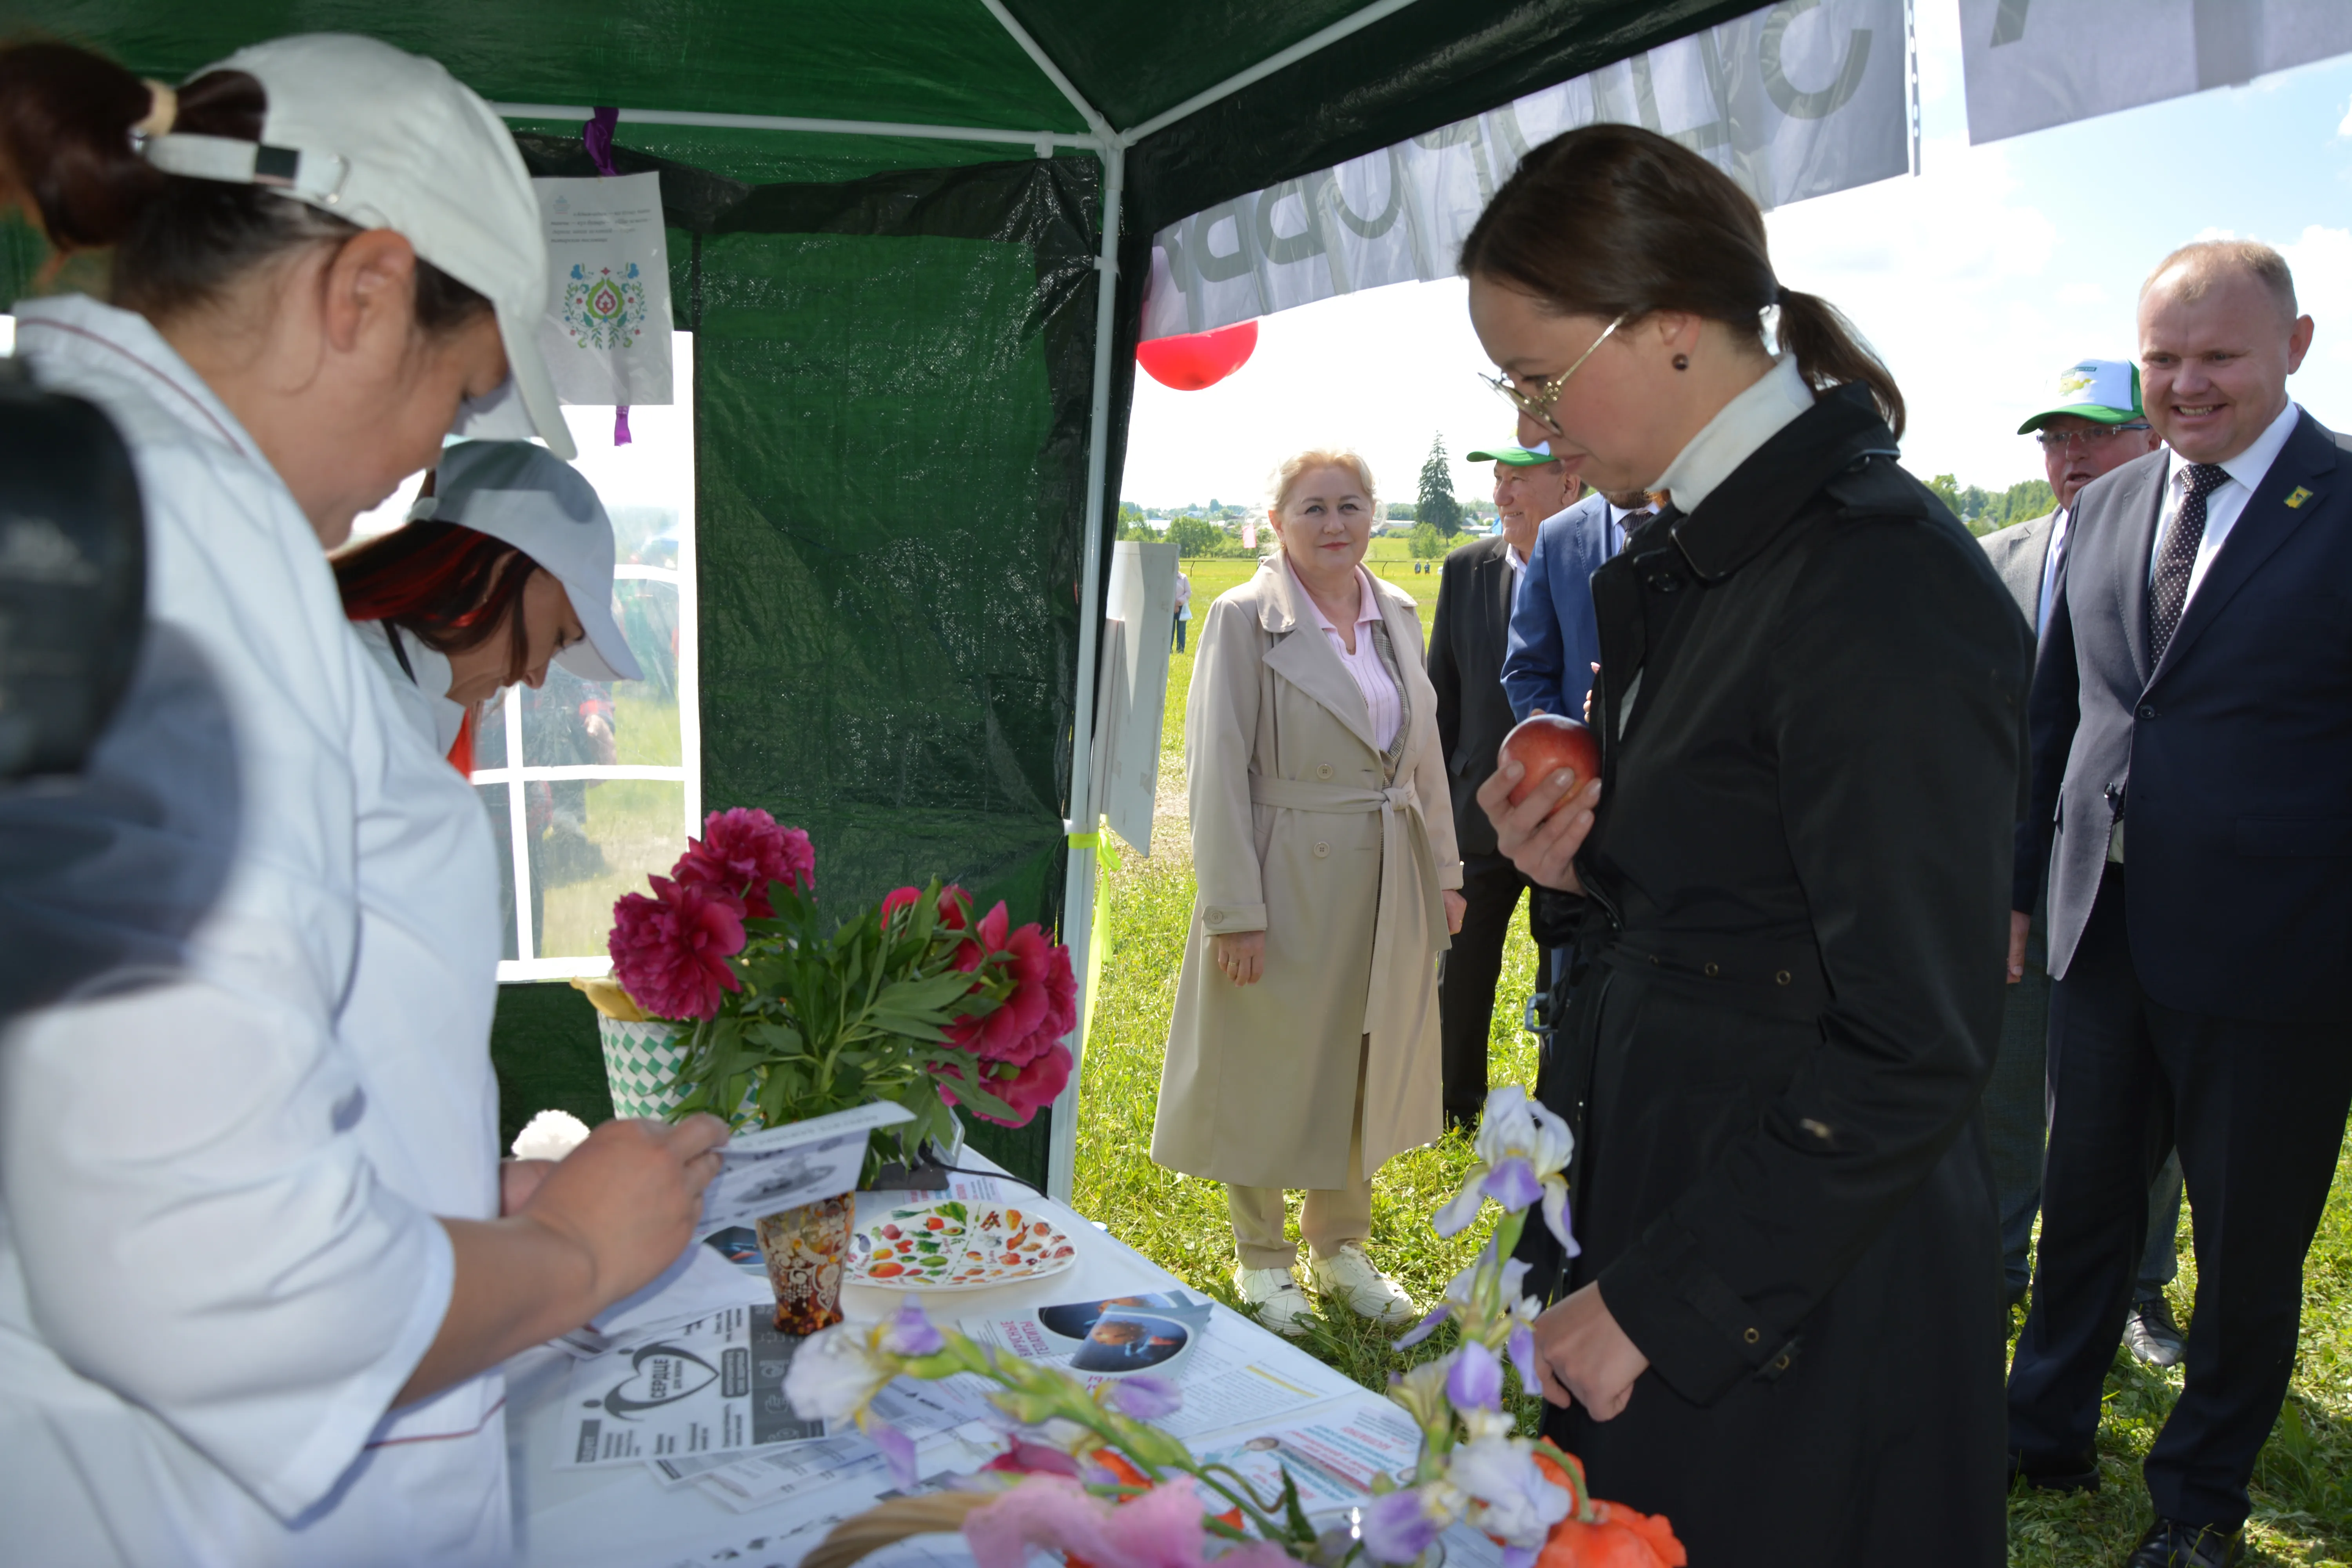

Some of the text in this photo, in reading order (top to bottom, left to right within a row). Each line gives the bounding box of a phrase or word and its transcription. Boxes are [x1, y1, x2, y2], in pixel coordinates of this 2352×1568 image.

[1000, 1320, 1033, 1357] ВИРУСНЫЕ
[1020, 1321, 1051, 1355] ГЕПАТИТЫ
[650, 1359, 671, 1398] СЕРДЦЕ
